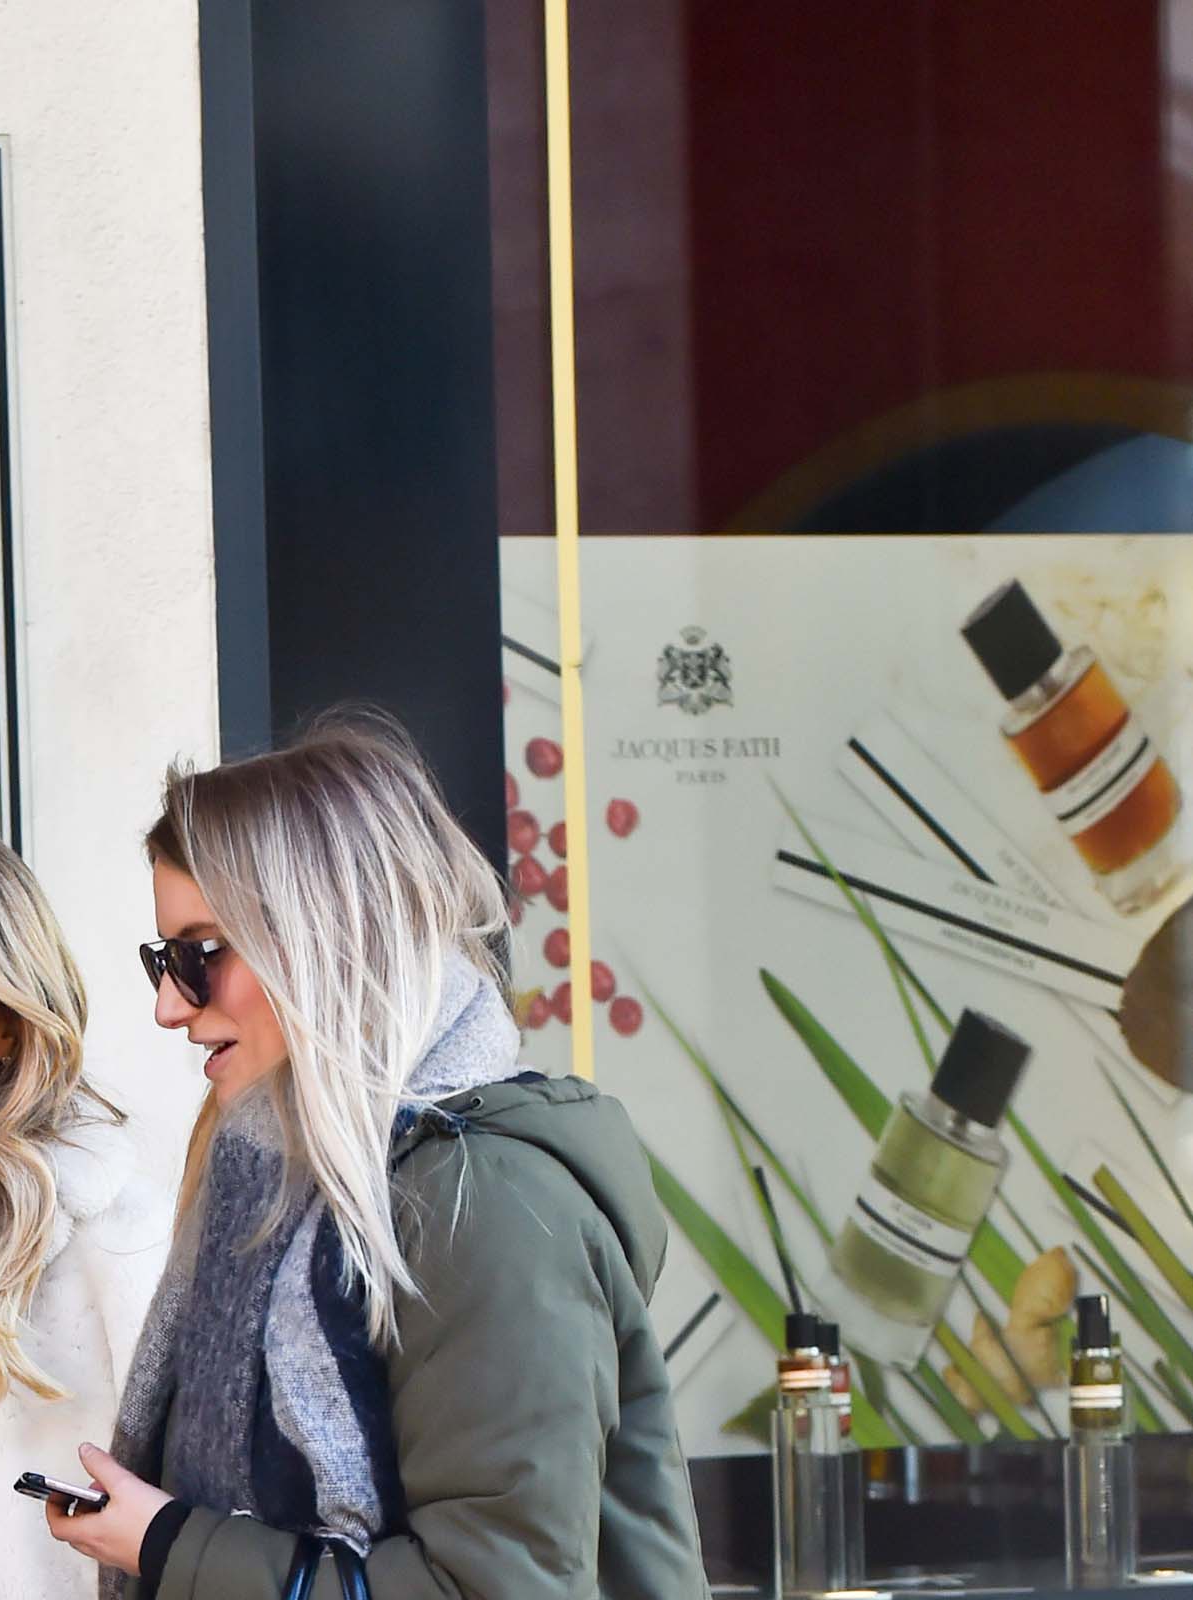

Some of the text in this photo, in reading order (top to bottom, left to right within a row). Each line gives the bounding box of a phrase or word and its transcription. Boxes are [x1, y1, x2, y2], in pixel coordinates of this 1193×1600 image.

[611, 737, 781, 763] JACQUES FATH
[675, 770, 727, 784] PARIS
